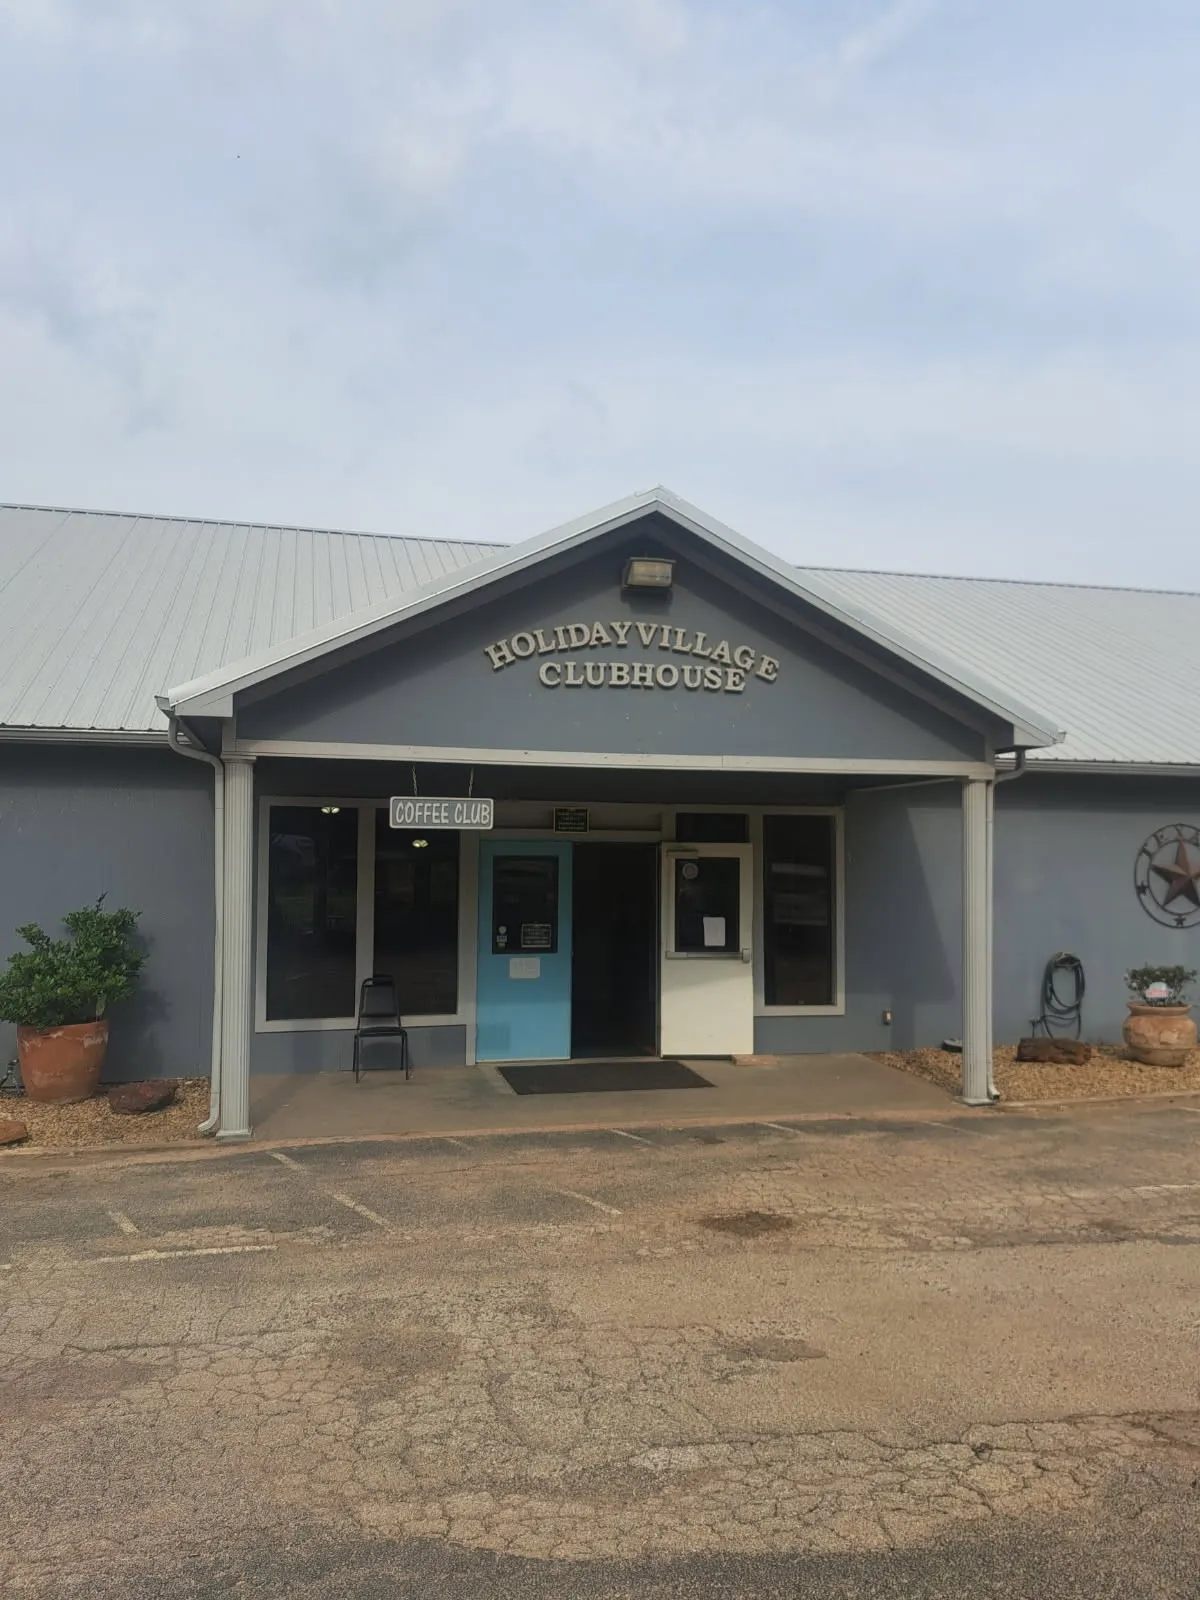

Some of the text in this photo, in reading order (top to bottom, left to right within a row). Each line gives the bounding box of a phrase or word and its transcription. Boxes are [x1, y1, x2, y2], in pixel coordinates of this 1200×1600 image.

[539, 661, 746, 692] CLUBHOUSE
[395, 802, 490, 824] COFFEE CLUB
